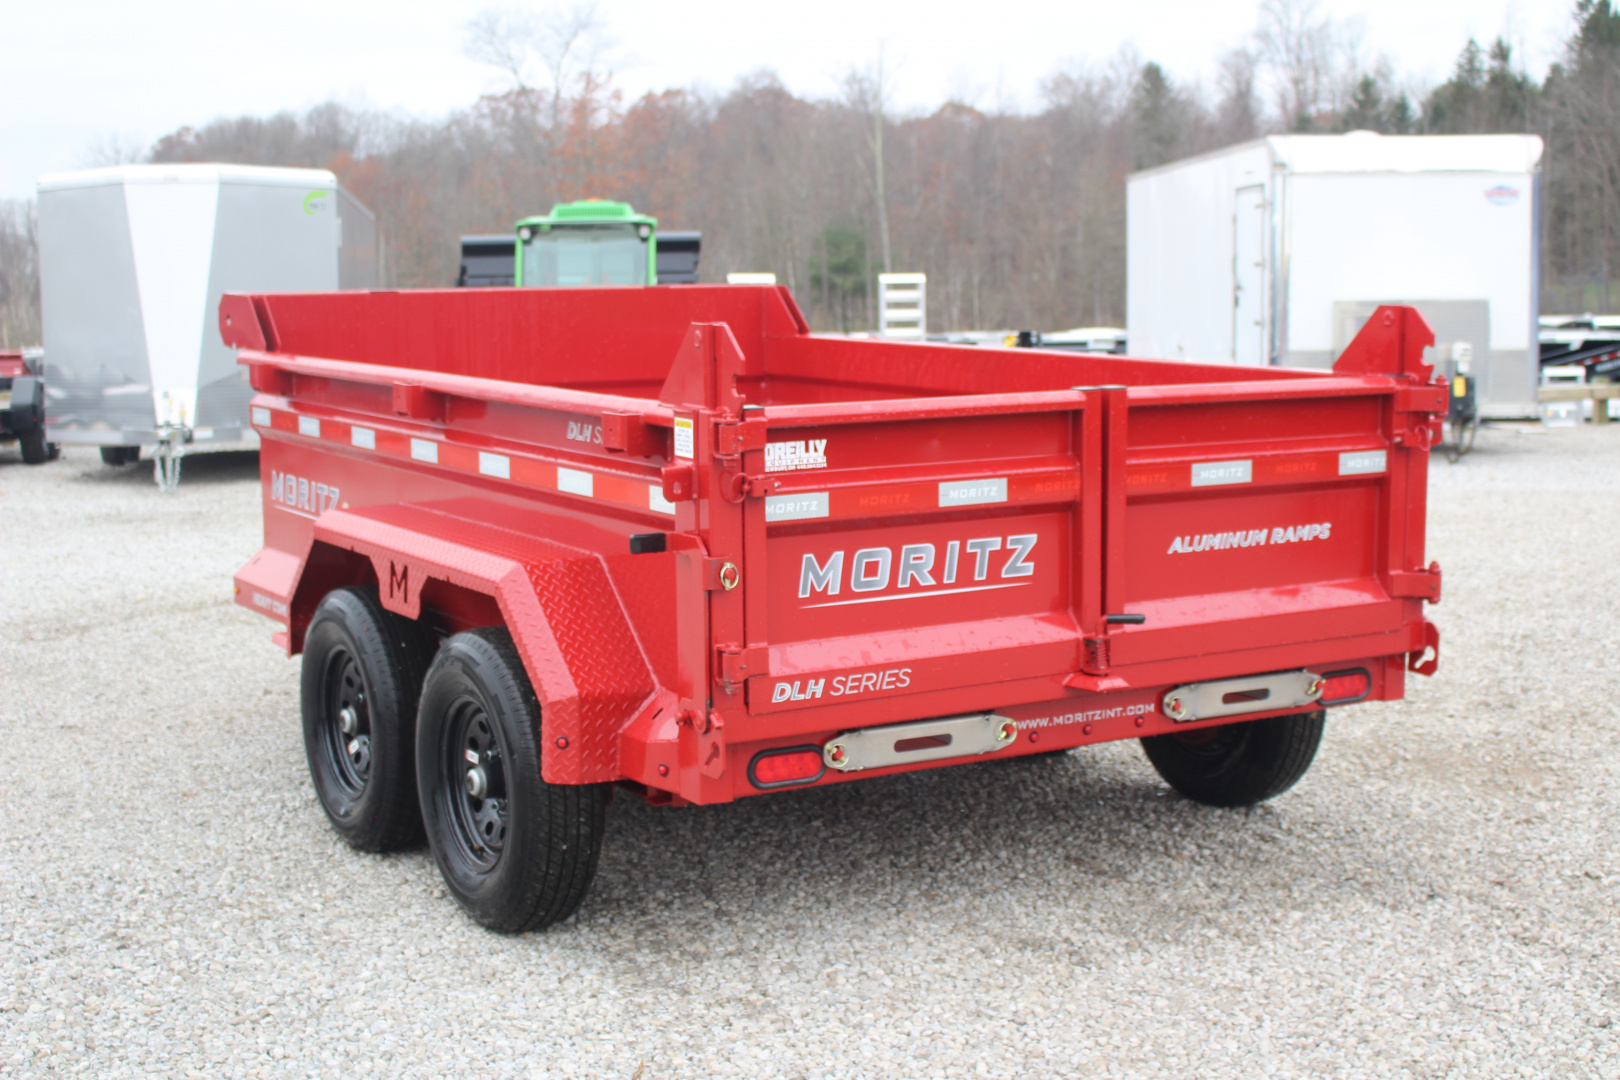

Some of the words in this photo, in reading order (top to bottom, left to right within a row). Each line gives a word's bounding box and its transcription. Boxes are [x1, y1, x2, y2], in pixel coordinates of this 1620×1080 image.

[566, 421, 593, 443] DLH
[1199, 467, 1244, 480] MORITZ
[271, 470, 340, 514] MORITZ
[859, 493, 911, 507] MORITZ
[949, 486, 998, 499] MORITZ
[766, 500, 818, 514] MORITZ
[1167, 528, 1268, 554] ALUMINUM
[1269, 522, 1332, 544] RAMPS
[798, 533, 1038, 598] MORITZ
[390, 560, 408, 604] M
[772, 679, 825, 703] DLH
[829, 668, 912, 696] SERIES
[1017, 703, 1155, 730] WWW.MORITZINT.COM
